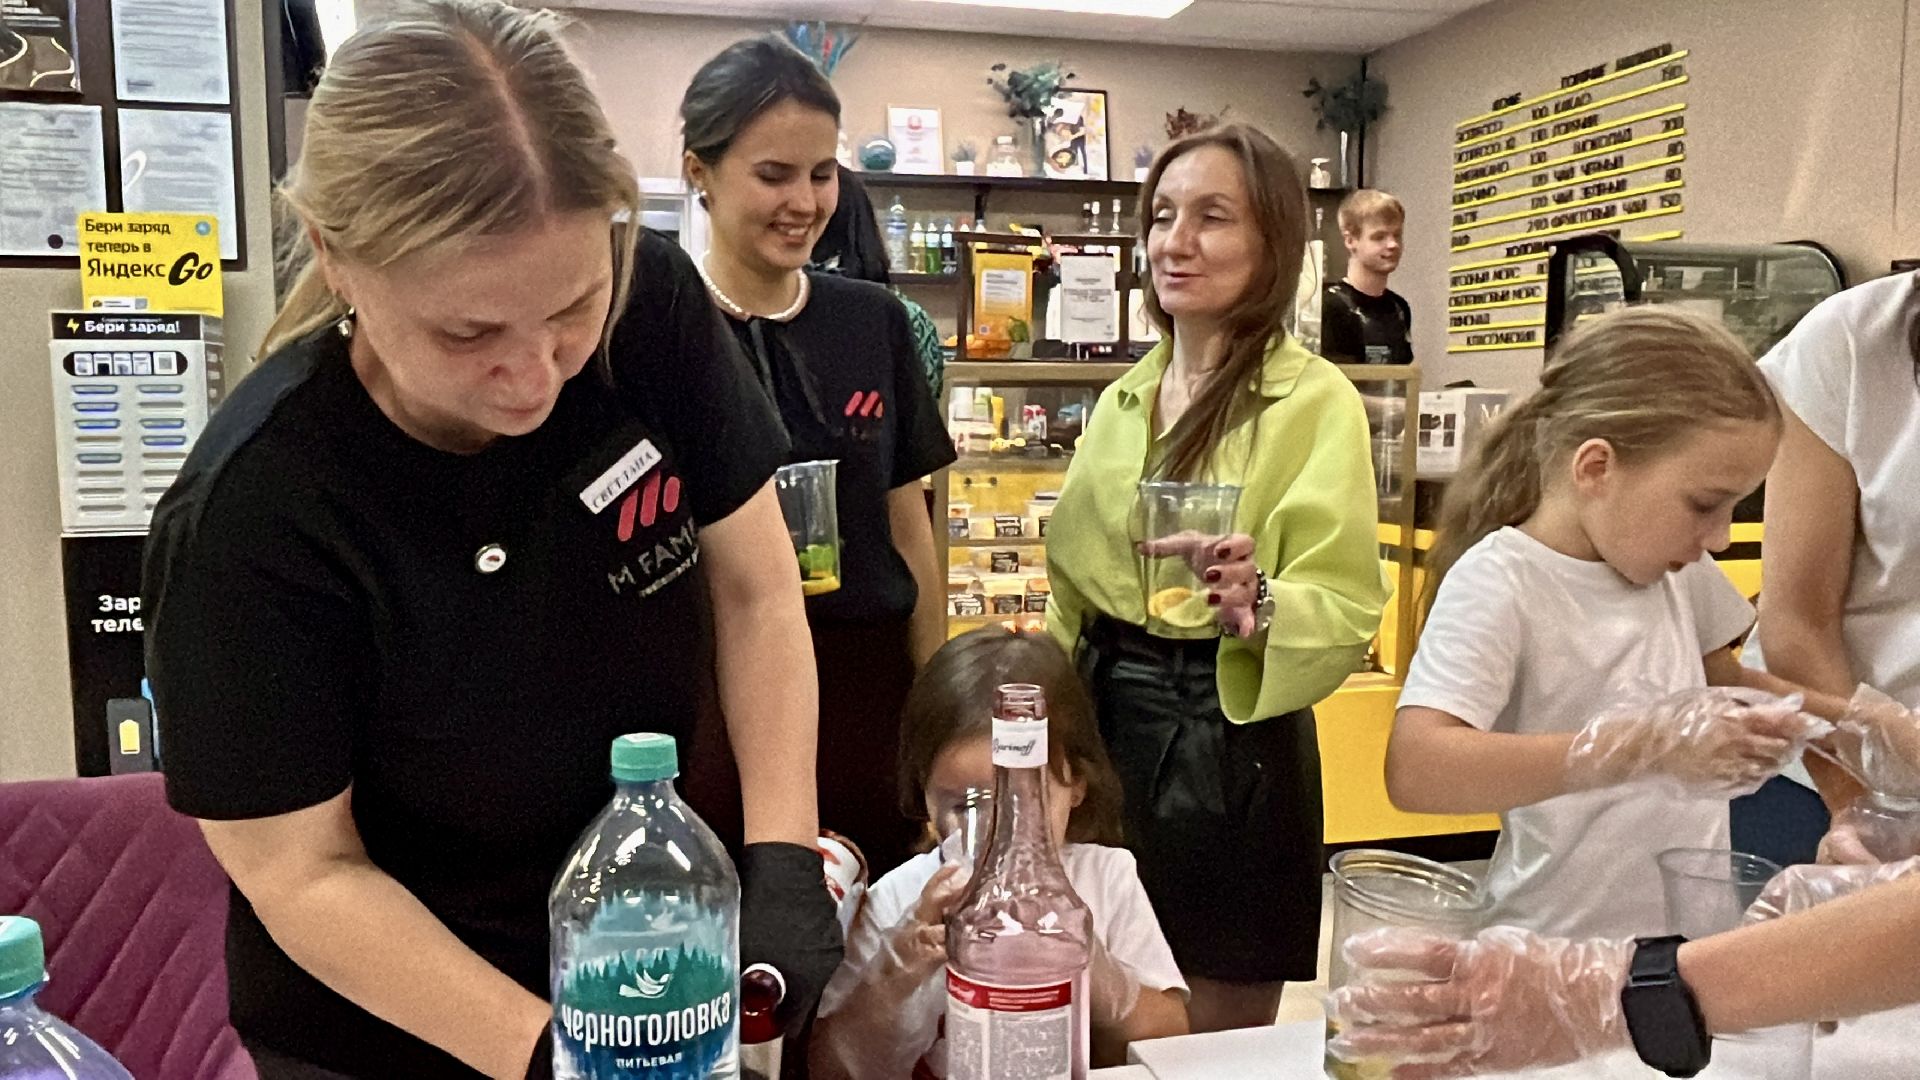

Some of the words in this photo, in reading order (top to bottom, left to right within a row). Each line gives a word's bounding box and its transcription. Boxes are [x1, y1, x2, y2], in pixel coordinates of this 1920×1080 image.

[84, 219, 123, 234] Бери
[127, 222, 171, 234] заряд
[87, 241, 139, 254] теперь
[143, 243, 151, 253] в
[87, 258, 166, 278] Яндекс
[168, 252, 213, 286] Go
[84, 320, 125, 334] Бери
[129, 320, 180, 334] заряд!
[607, 565, 637, 595] M
[615, 1052, 683, 1069] ПИТЬЕВАЯ
